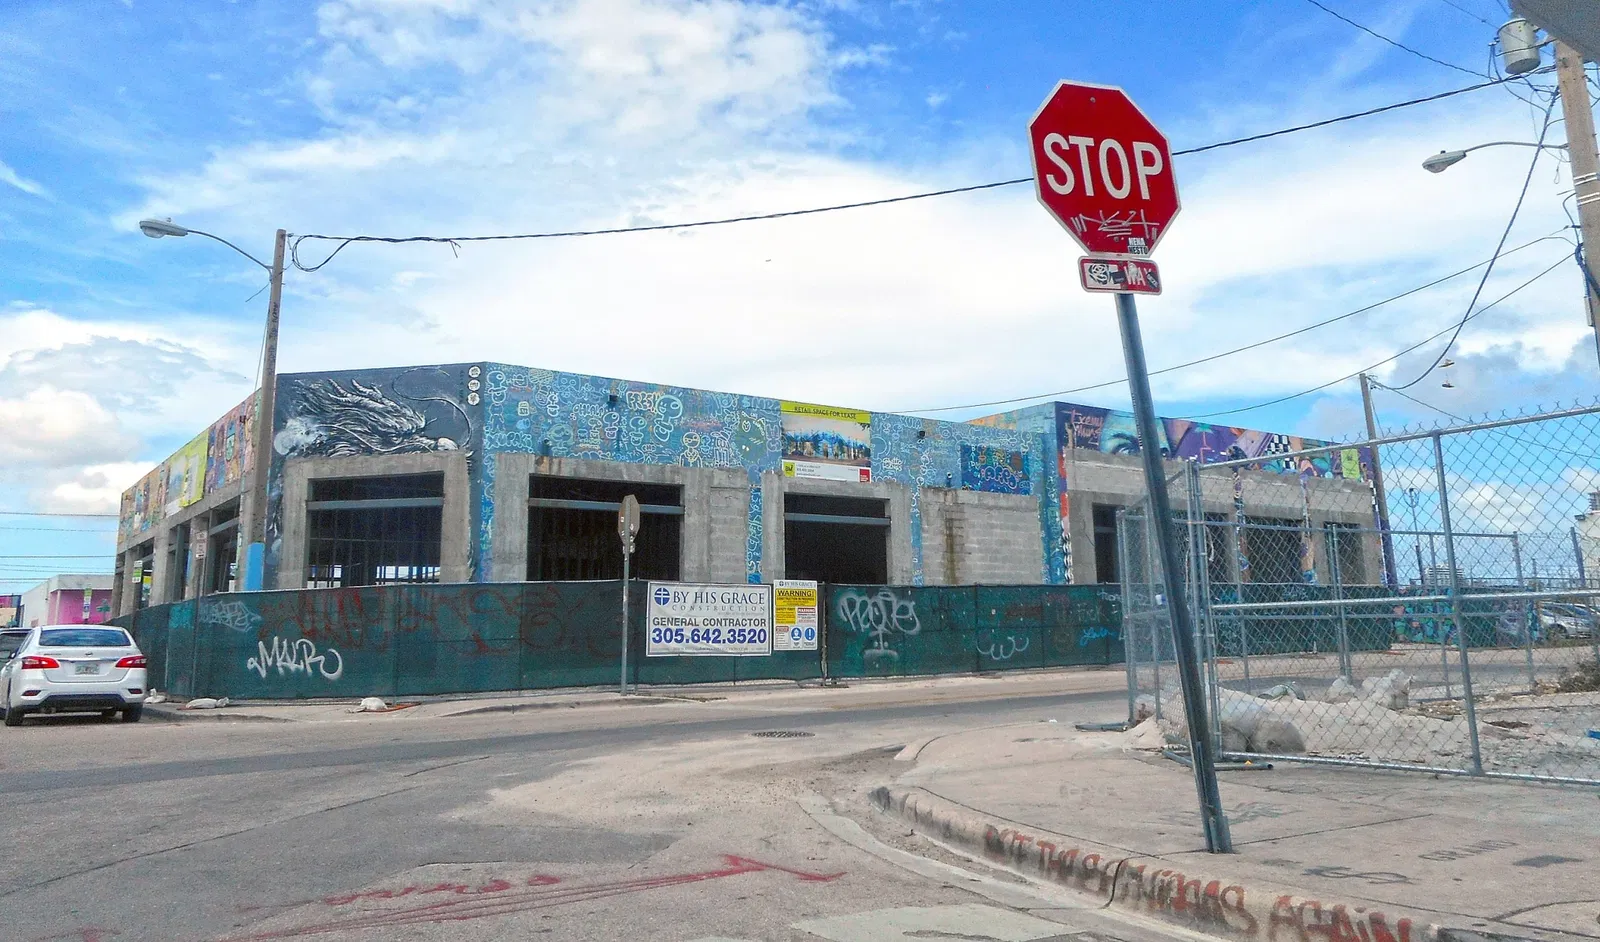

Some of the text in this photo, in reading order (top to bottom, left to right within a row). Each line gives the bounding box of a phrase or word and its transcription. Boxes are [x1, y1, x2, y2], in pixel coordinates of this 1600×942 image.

[1043, 132, 1164, 200] STOP
[672, 591, 764, 605] BY HIS GRACE
[652, 617, 767, 627] GENERAL CONTRACTOR
[651, 627, 767, 644] 305.642.3520
